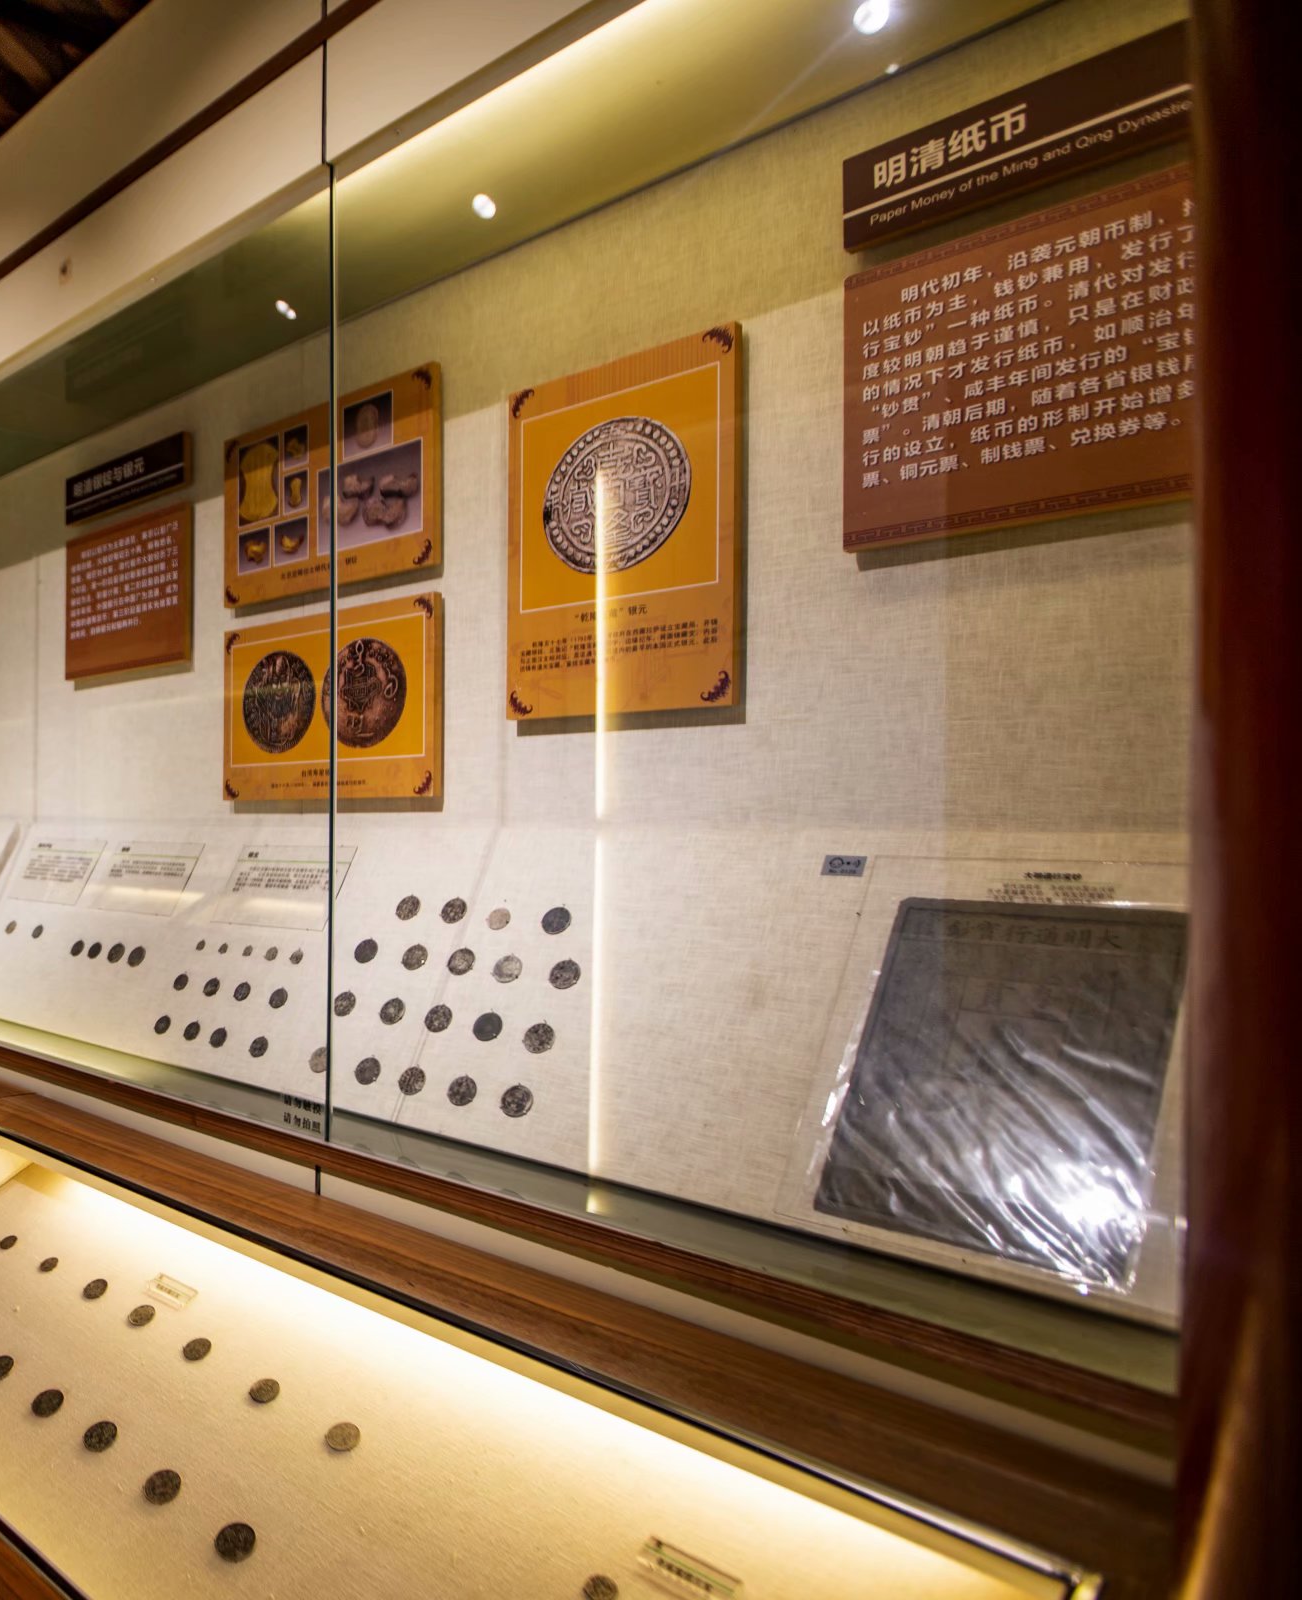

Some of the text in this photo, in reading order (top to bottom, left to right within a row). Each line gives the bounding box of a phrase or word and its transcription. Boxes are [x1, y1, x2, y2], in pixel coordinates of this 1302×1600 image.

[870, 203, 908, 227] Paper
[910, 185, 958, 210] Money
[959, 178, 974, 193] of
[975, 168, 1000, 187] the
[1002, 155, 1040, 178] Ming
[1042, 143, 1073, 163] and
[1074, 126, 1115, 150] Qing
[873, 103, 1028, 190] 明清纸币
